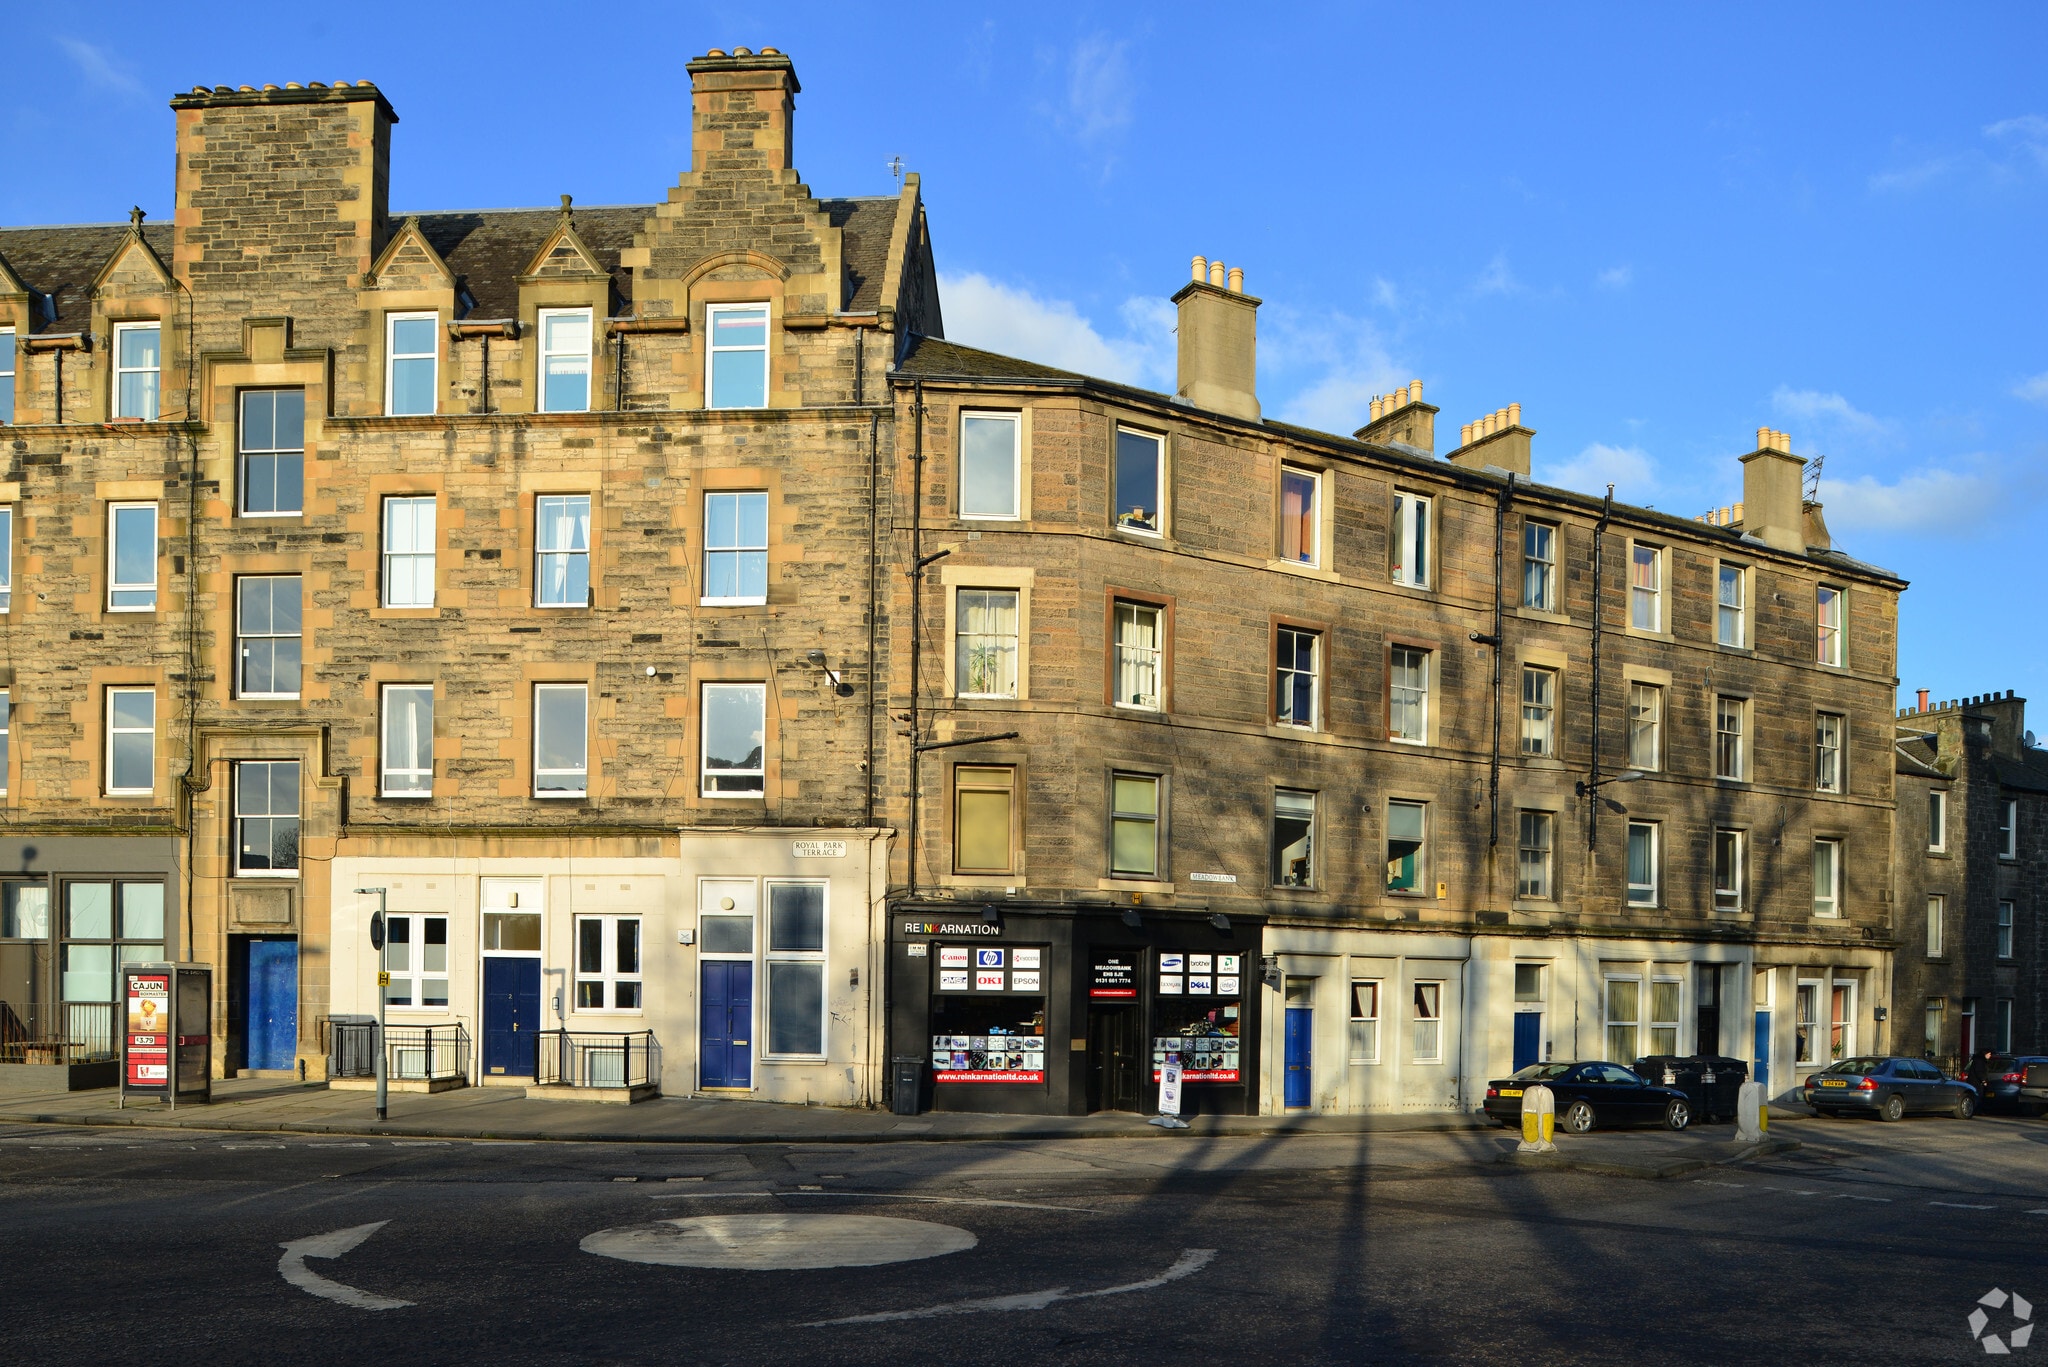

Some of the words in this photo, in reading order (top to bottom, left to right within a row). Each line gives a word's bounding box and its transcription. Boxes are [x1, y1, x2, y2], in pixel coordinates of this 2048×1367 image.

[905, 923, 999, 935] REINKARNATION
[1190, 981, 1210, 989] DELL
[936, 1073, 1039, 1081] www.reinkarnationltd.co.uk
